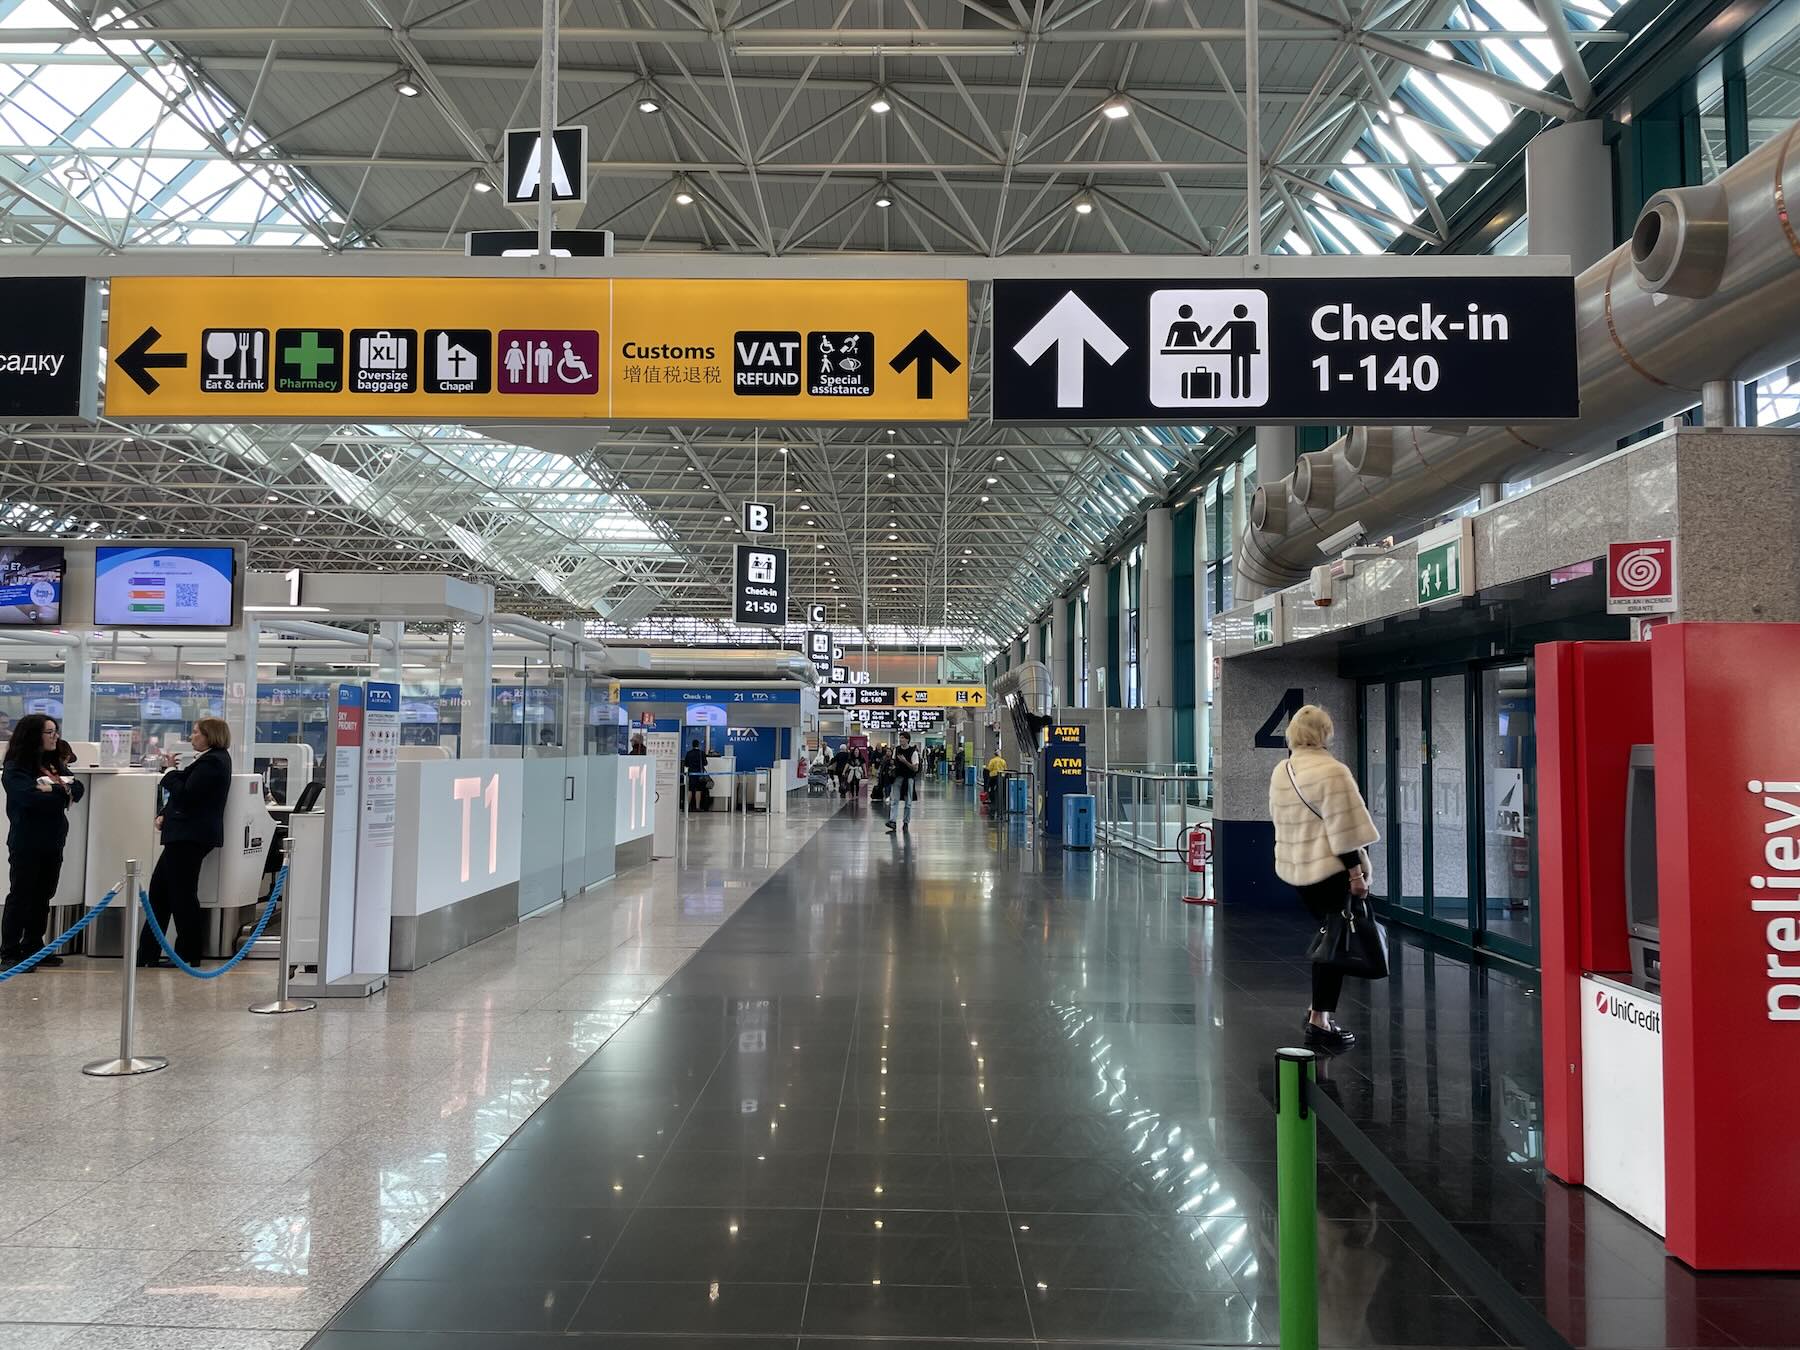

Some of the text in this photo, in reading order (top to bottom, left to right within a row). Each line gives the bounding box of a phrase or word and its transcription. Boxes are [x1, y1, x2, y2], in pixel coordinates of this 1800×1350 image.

[516, 136, 573, 198] A
[1310, 303, 1508, 341] Check-in
[372, 346, 395, 360] XL
[622, 341, 715, 360] Customs
[736, 342, 800, 366] VAT
[358, 370, 408, 380] Oversize
[623, 365, 722, 385] 增值税退税
[736, 372, 799, 386] REFUND
[1311, 354, 1440, 393] 1-140
[206, 379, 264, 389] Eat & drink
[280, 379, 337, 390] Pharmacy
[357, 380, 408, 392] baggage
[440, 382, 474, 392] Chapel
[820, 374, 862, 388] Special
[811, 384, 870, 395] assistance
[749, 505, 768, 531] B
[285, 568, 300, 606] 1
[745, 586, 777, 597] Check-in
[745, 601, 777, 614] 21-50
[813, 607, 823, 621] C
[833, 648, 842, 659] D
[49, 685, 60, 693] 28
[370, 690, 391, 699] ITA
[734, 693, 744, 702] 21
[338, 712, 347, 721] SKY
[1255, 688, 1304, 758] 4
[728, 728, 759, 736] ITA
[1055, 727, 1079, 735] ATM
[1053, 759, 1082, 767] ATM
[454, 774, 499, 882] T1
[1610, 997, 1661, 1033] UniCredit
